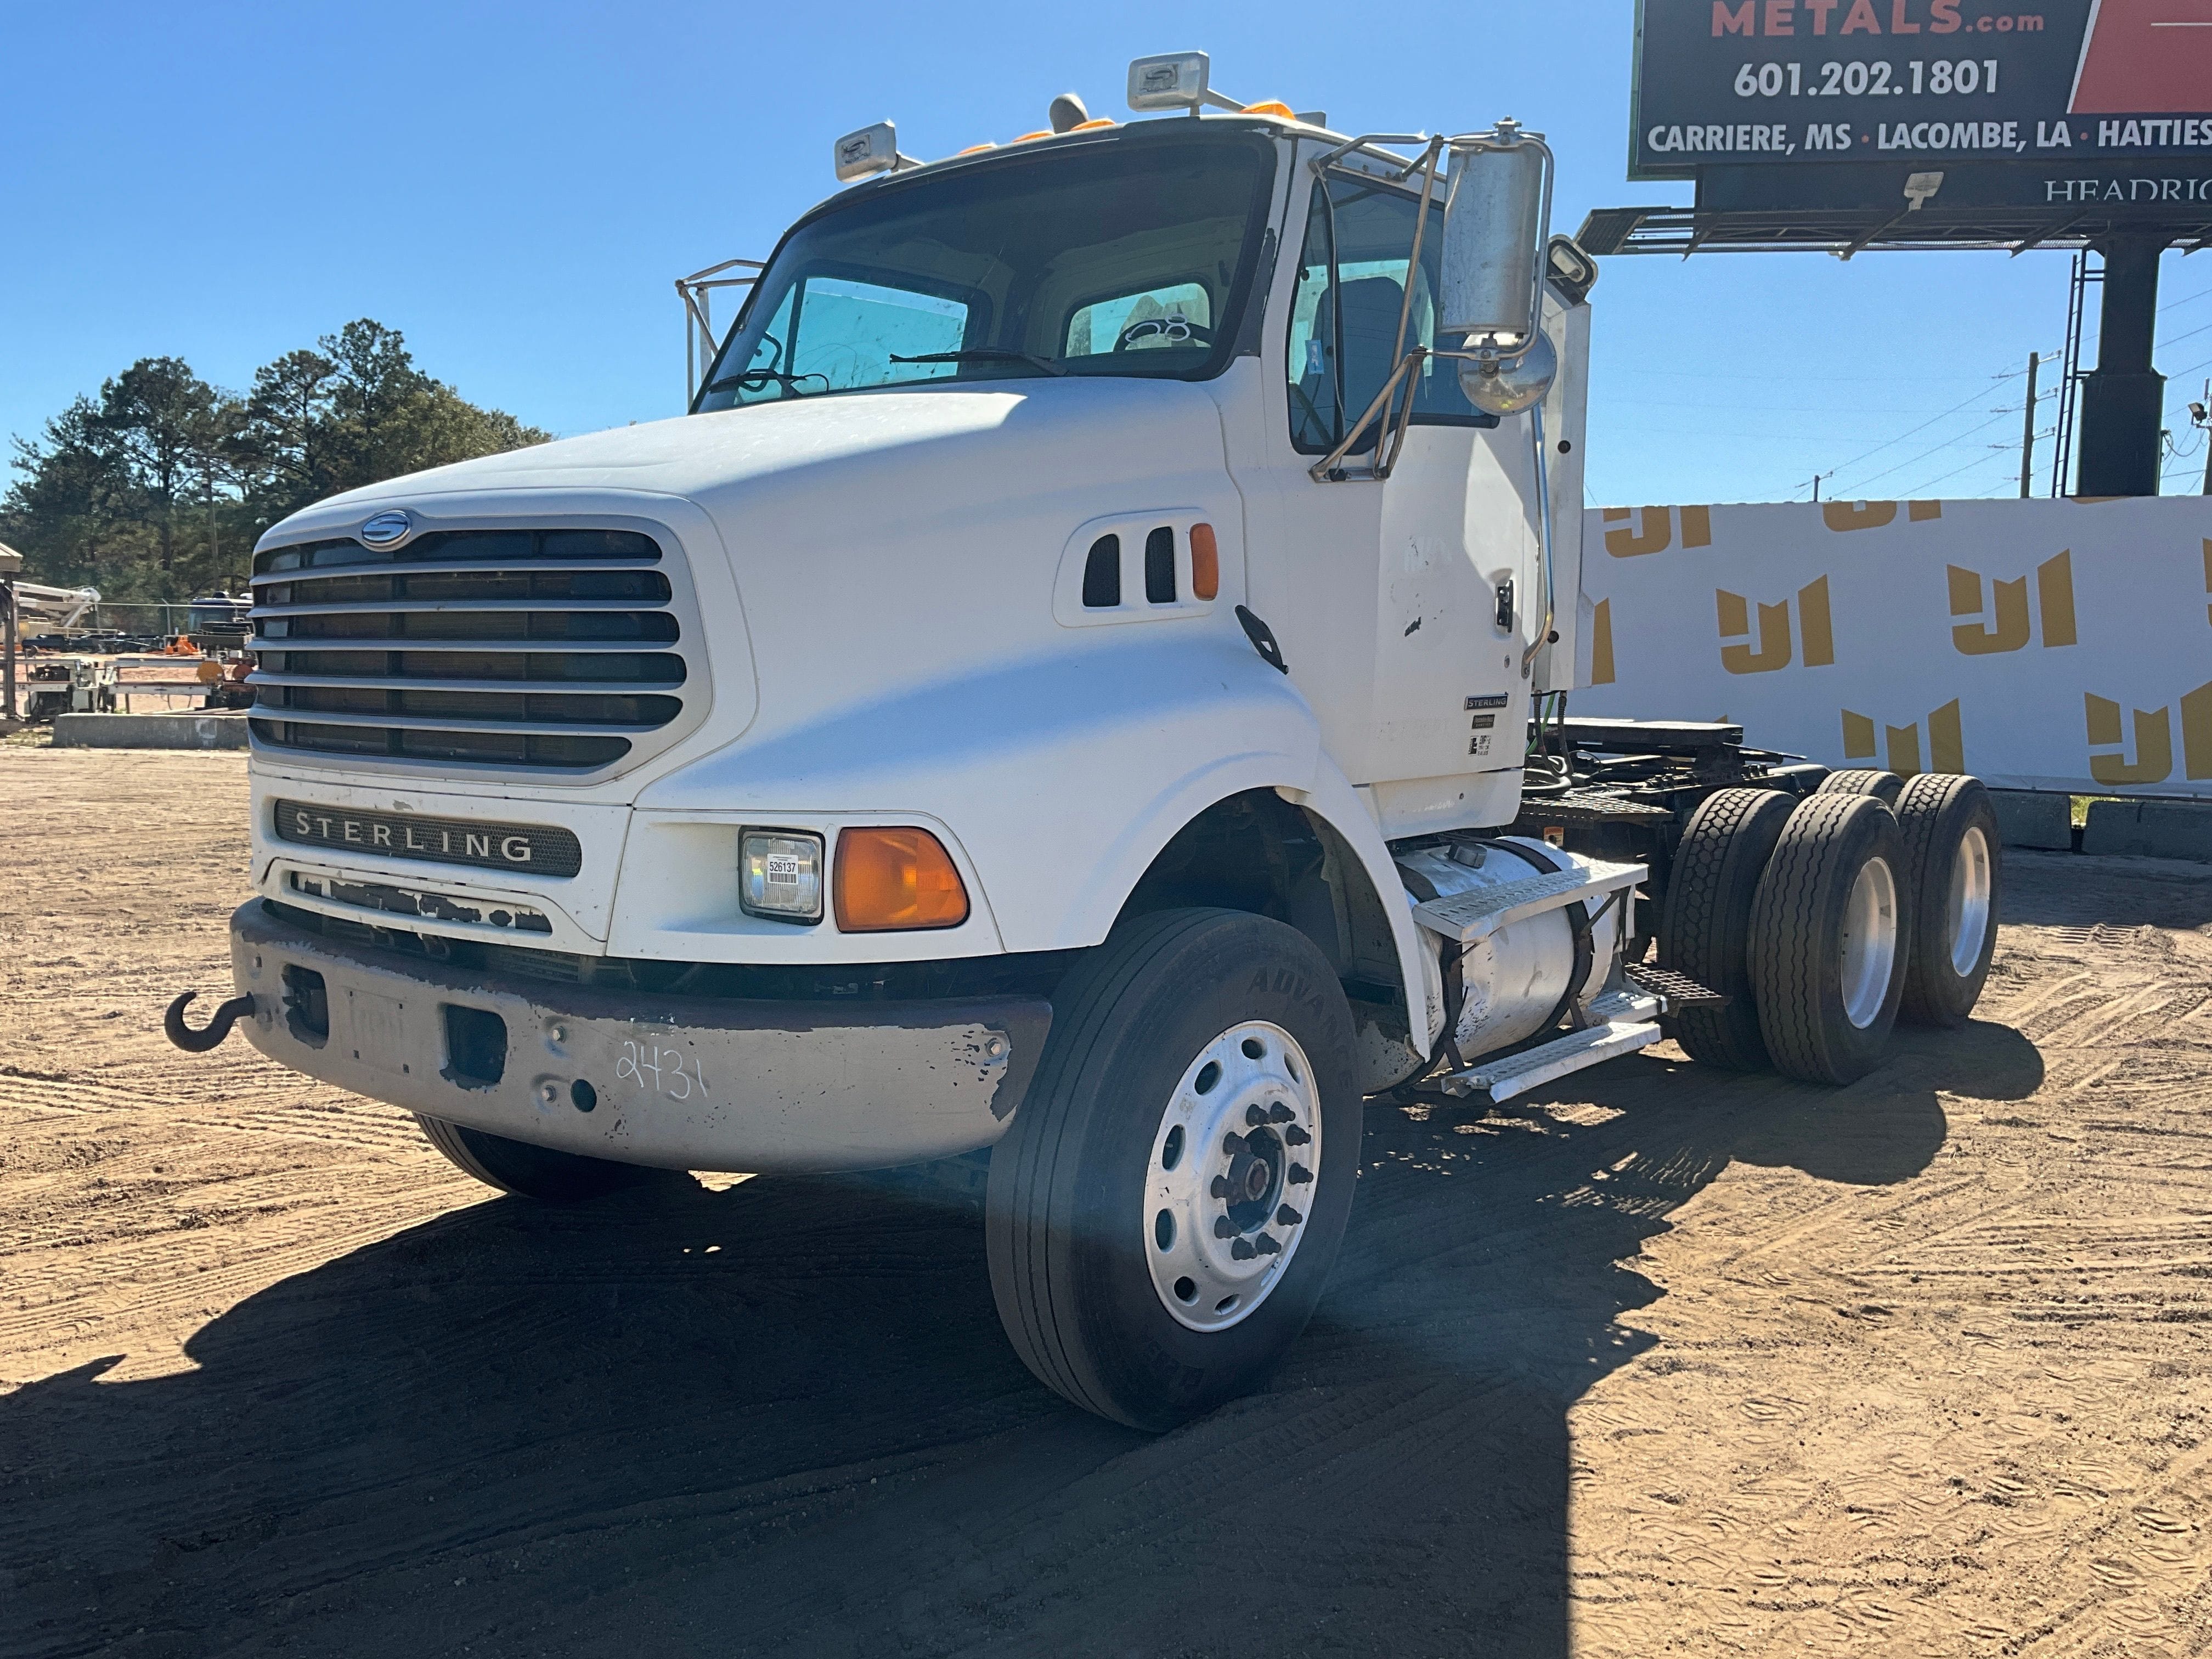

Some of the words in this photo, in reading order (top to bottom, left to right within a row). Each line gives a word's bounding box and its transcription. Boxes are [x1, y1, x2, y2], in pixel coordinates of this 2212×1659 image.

[1734, 59, 1998, 97] 601.202.1801
[1647, 123, 1796, 155] CARRIERE,
[1804, 123, 1850, 150] MS
[1877, 121, 2027, 153] LACOMBE,
[2036, 121, 2072, 148] LA
[1468, 698, 1506, 707] STERLING
[296, 812, 532, 862] STERLING
[769, 861, 795, 872] 526137
[616, 1041, 708, 1099] 2431
